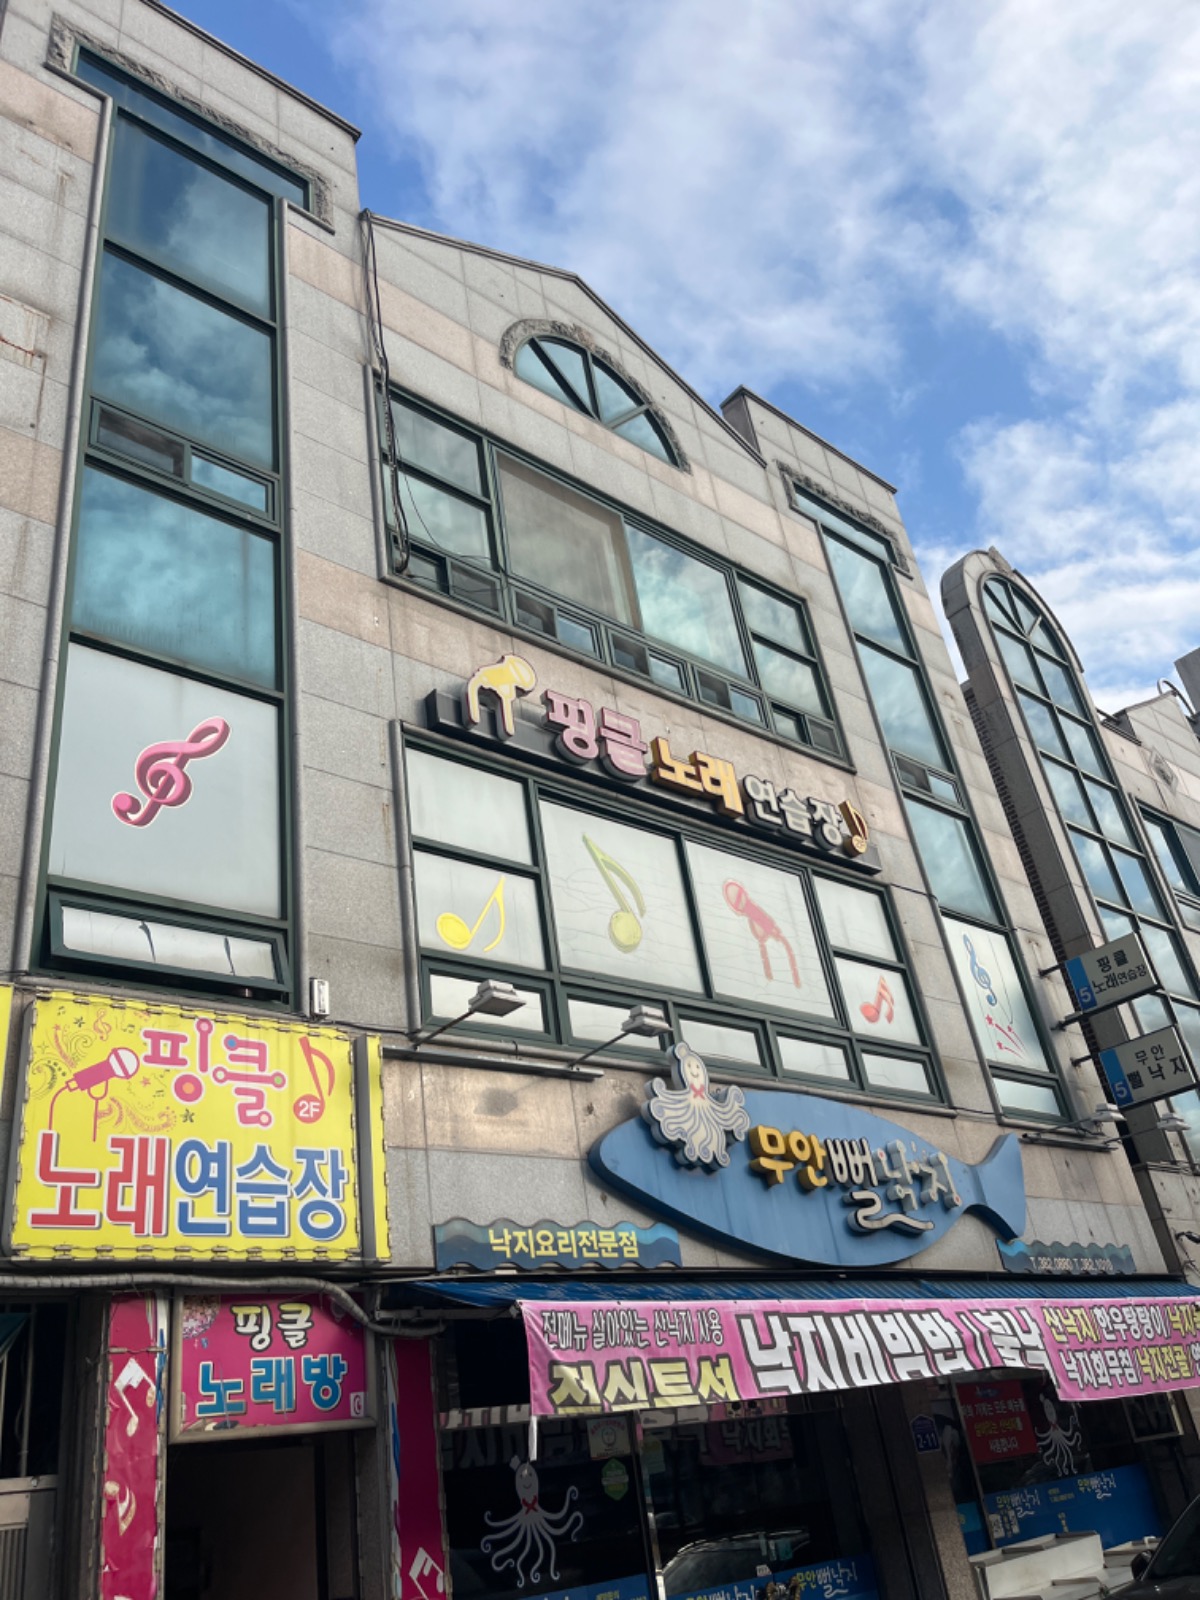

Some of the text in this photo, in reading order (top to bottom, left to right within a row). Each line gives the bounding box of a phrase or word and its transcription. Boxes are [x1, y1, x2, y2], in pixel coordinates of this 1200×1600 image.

[545, 690, 647, 778] 핑클
[1096, 949, 1129, 973] 핑클
[1079, 986, 1092, 1003] 5
[1092, 964, 1147, 994] 노래연습장
[1135, 1044, 1165, 1063] 무안
[142, 1018, 286, 1127] 핑클
[1114, 1081, 1128, 1099] 5
[297, 1099, 321, 1119] 2F
[28, 1131, 348, 1240] 노래연습장
[488, 1228, 640, 1259] 낙지요리전문점
[230, 1302, 314, 1352] 핑클
[541, 1308, 725, 1351] 전메뉴 살아있는 산낙지 사용
[196, 1354, 348, 1416] 노래방
